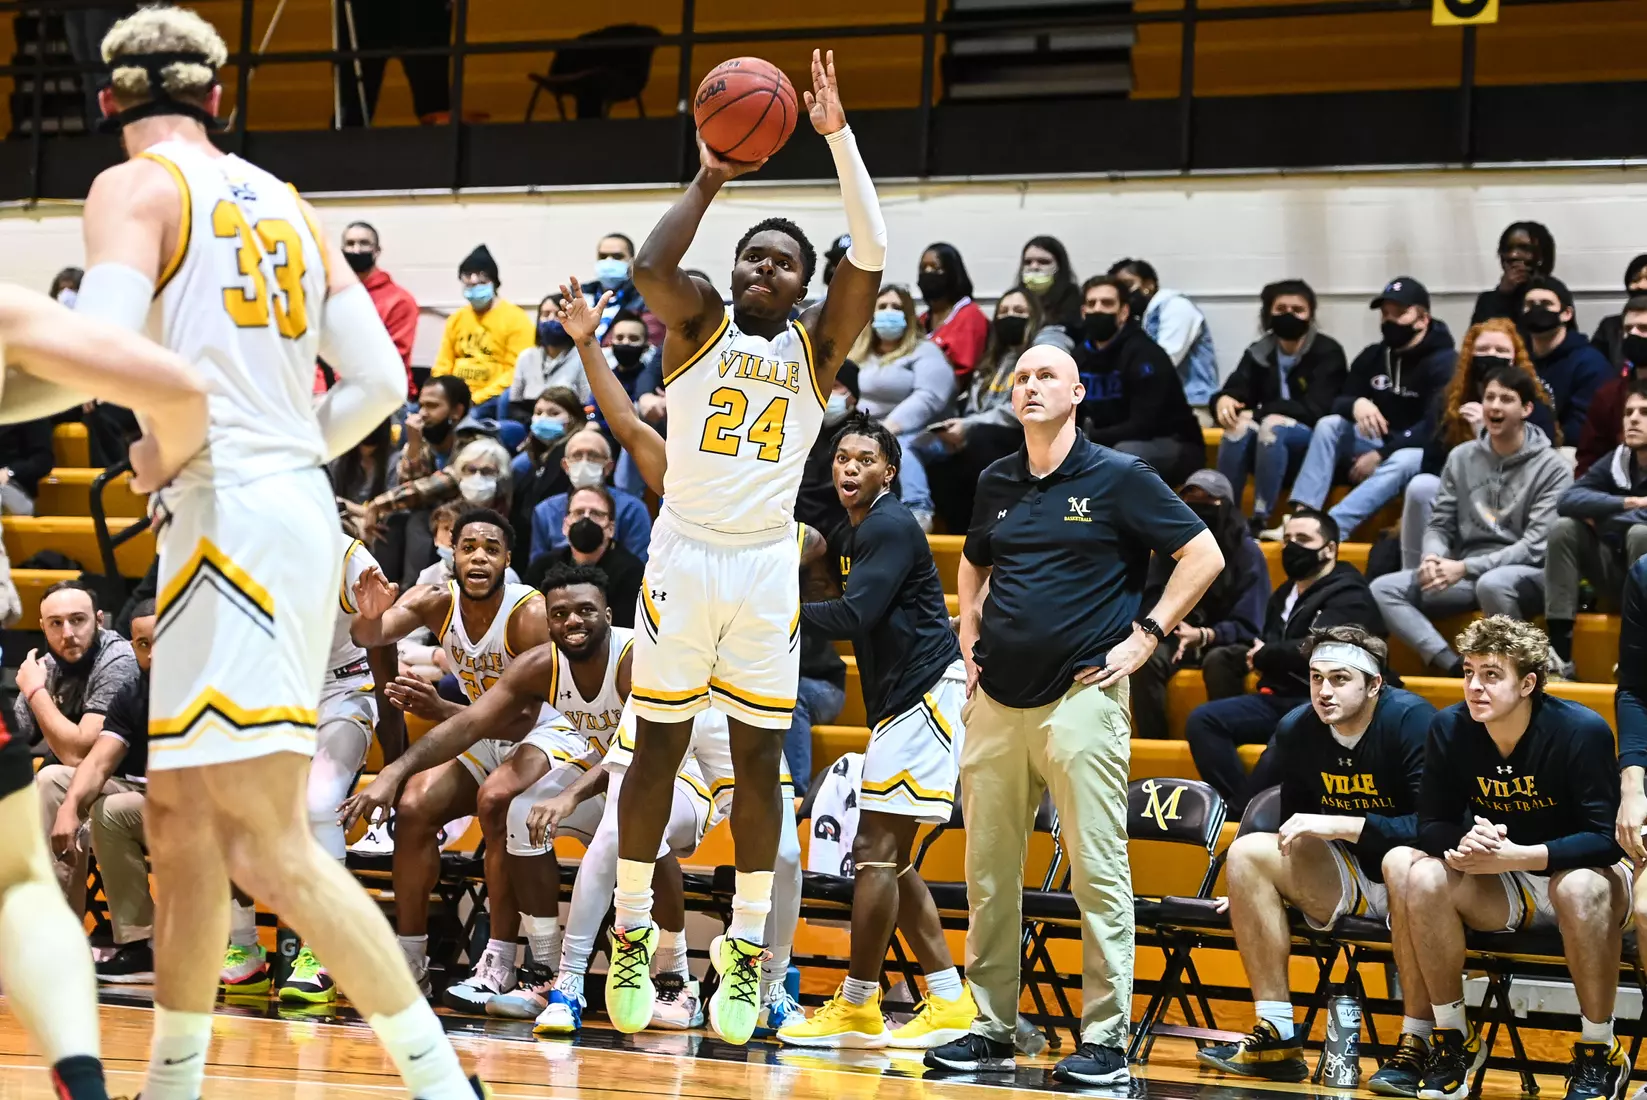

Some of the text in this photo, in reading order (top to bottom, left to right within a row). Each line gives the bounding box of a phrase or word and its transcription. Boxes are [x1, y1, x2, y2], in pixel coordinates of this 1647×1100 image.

[211, 198, 307, 340] 33
[717, 349, 800, 394] VILLE
[699, 386, 790, 463] 24
[450, 645, 504, 674] VILLE
[1320, 771, 1379, 796] VILLE
[1476, 775, 1538, 797] VILLE
[1321, 795, 1396, 811] ASKETBALL
[280, 938, 297, 957] G
[1345, 1008, 1361, 1018] VAN
